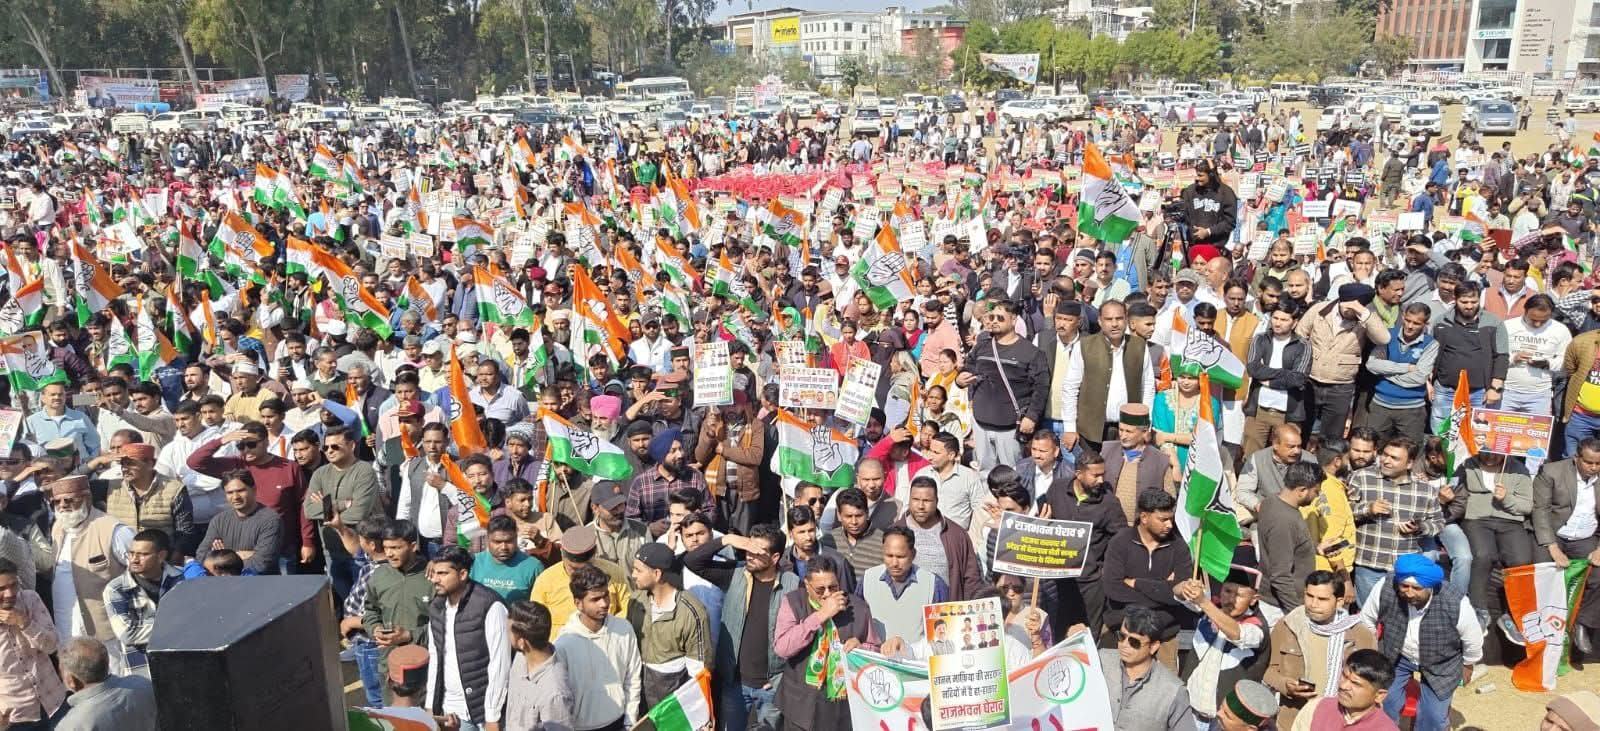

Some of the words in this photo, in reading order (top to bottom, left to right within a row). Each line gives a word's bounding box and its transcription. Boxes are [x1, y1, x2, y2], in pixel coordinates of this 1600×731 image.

[1514, 335, 1549, 345] TOMMY
[1015, 520, 1053, 535] राजभवन
[1054, 524, 1076, 537] घेराव
[952, 671, 975, 684] माफिया
[975, 669, 983, 682] की
[942, 687, 960, 699] नदियों
[967, 686, 973, 697] है
[939, 702, 981, 720] राजभवन
[981, 698, 1004, 714] घेराव
